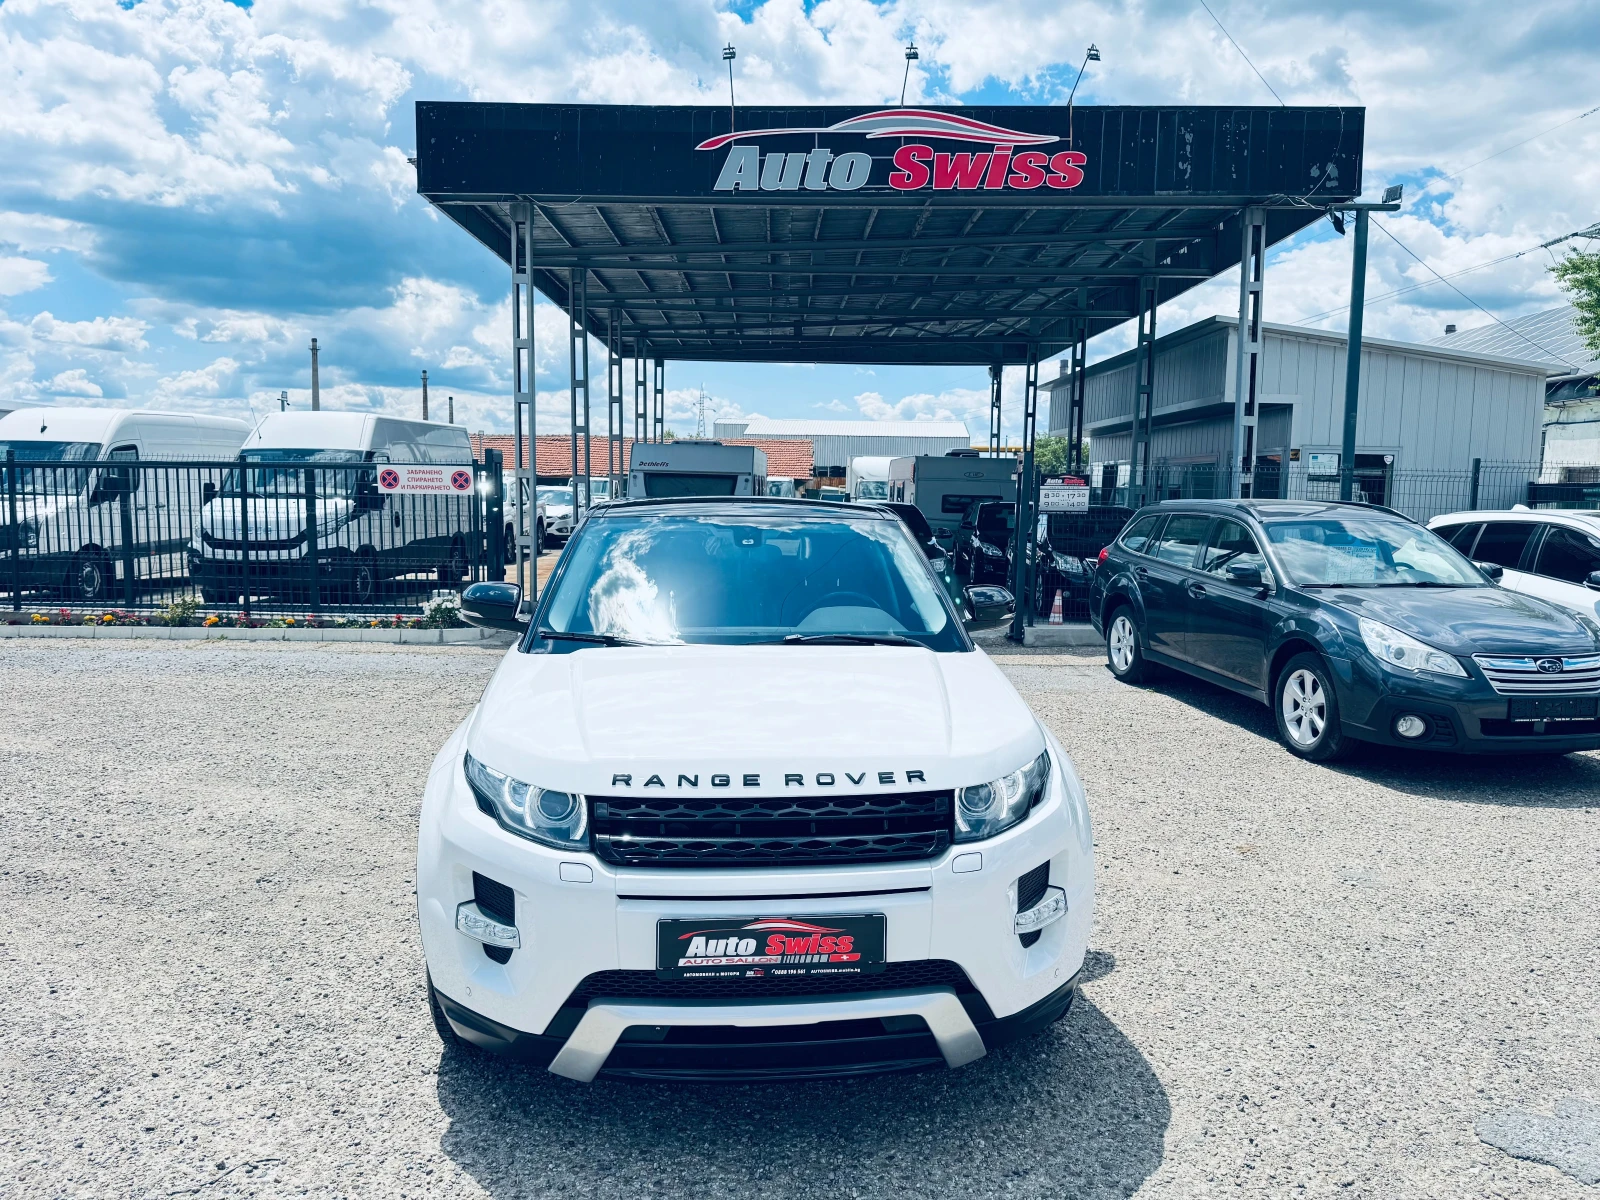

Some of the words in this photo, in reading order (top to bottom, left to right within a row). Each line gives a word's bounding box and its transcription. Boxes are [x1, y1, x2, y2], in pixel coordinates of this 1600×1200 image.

[712, 144, 873, 191] Auto
[888, 143, 1088, 191] Swiss
[611, 773, 762, 787] RANGE
[784, 769, 927, 786] ROVER
[685, 936, 758, 958] Auto
[764, 933, 855, 956] Swiss
[682, 957, 723, 966] AUTO
[725, 956, 779, 965] SALLON
